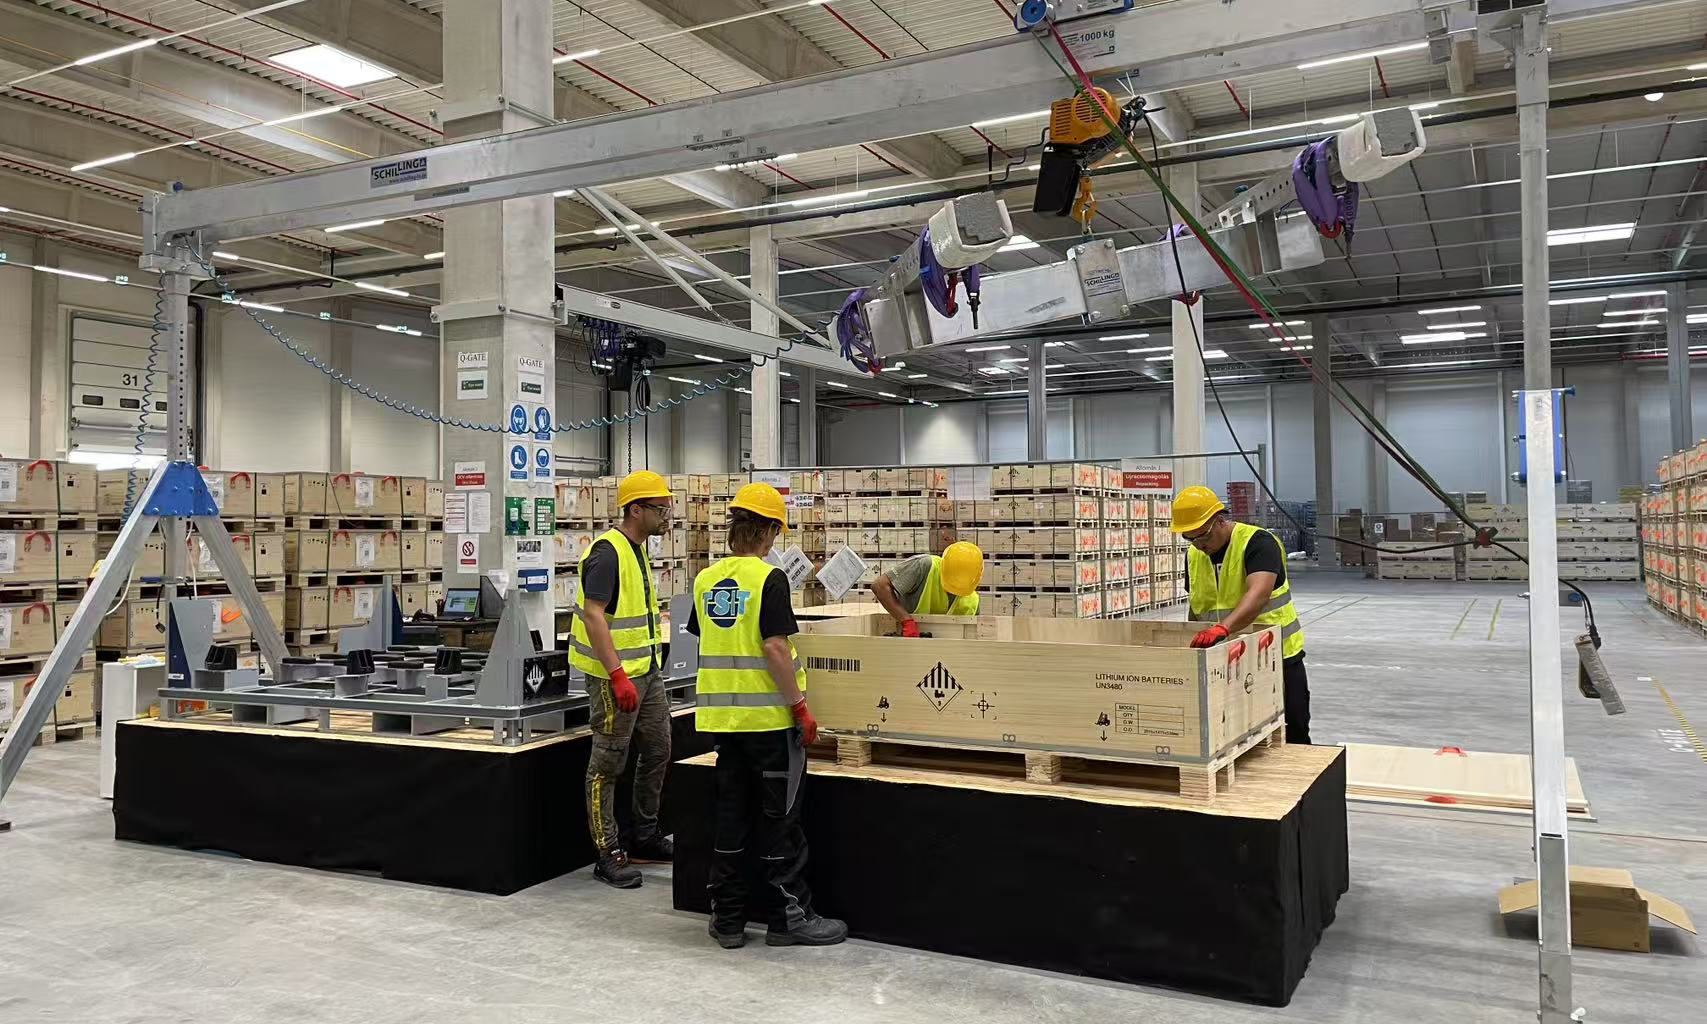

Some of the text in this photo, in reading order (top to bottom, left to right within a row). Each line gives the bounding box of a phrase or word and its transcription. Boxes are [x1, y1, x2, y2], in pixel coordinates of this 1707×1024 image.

[1080, 31, 1101, 42] 1000
[1103, 29, 1115, 39] kg
[374, 158, 420, 180] SCHILLING
[460, 353, 487, 363] Q-GATE
[519, 357, 543, 369] Q-GATE
[122, 373, 138, 387] 31
[1095, 673, 1125, 682] LITHIUM
[1141, 676, 1184, 685] BATTERIES
[1095, 682, 1123, 690] UN3480
